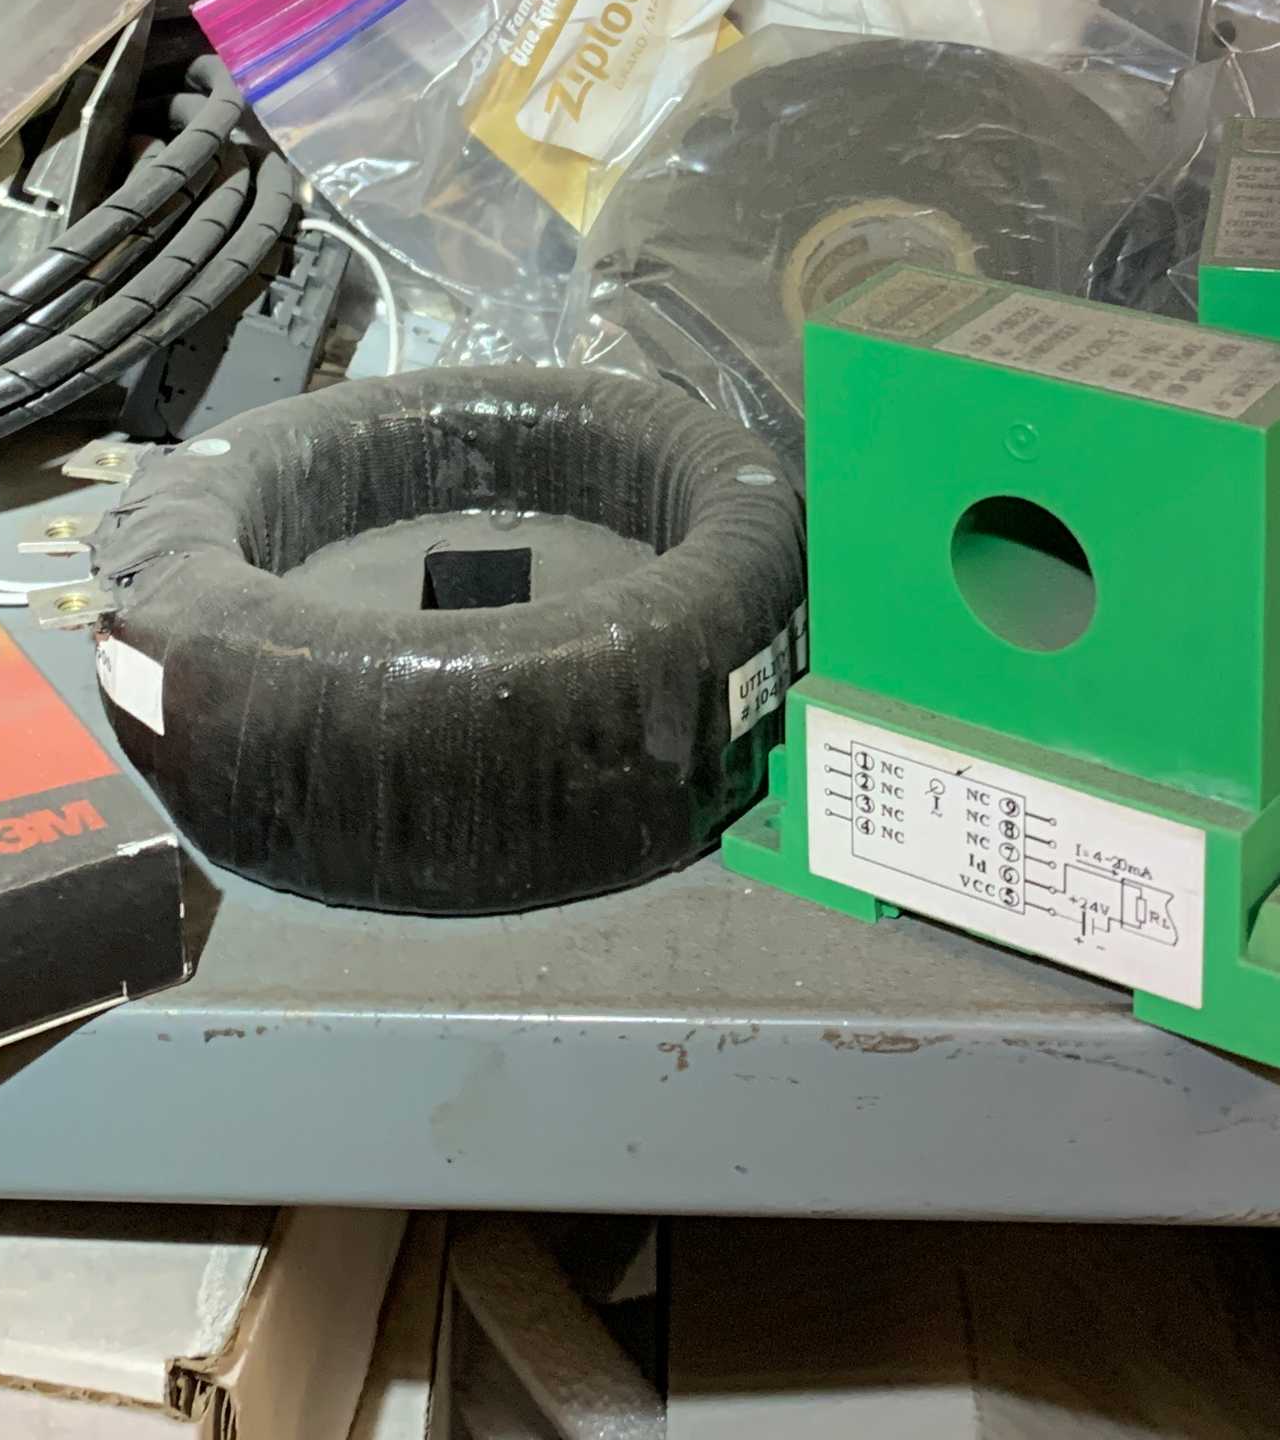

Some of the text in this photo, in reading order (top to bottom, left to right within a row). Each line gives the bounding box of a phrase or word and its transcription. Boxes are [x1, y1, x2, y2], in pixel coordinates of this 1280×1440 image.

[881, 760, 905, 779] NC
[881, 782, 905, 800] NC
[966, 788, 991, 806] NC
[881, 805, 905, 822] NC
[966, 809, 991, 827] NC
[881, 826, 905, 844] NC
[966, 832, 991, 849] NC
[959, 874, 996, 897] VCC
